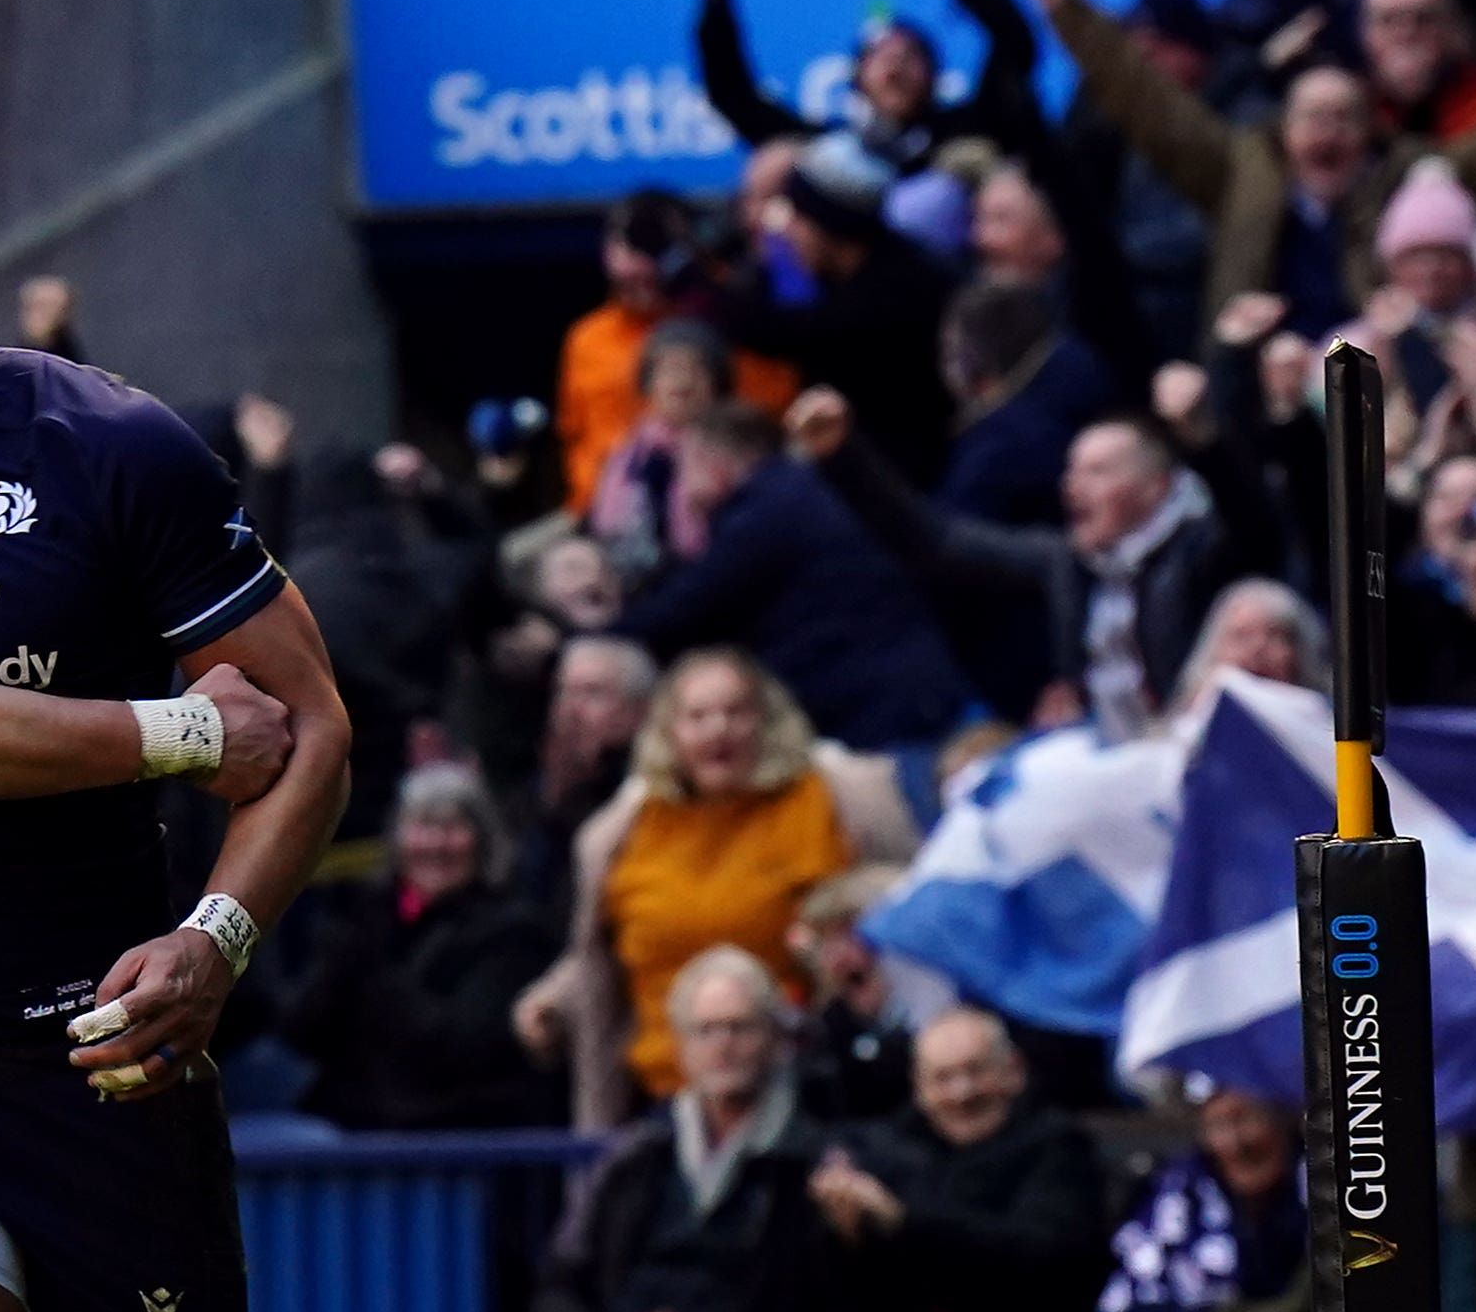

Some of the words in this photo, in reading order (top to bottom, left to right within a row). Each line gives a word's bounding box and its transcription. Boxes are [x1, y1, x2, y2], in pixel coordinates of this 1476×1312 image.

[431, 69, 740, 167] Scottis
[1330, 914, 1379, 979] 0.0
[1343, 993, 1388, 1220] GUINNESS
